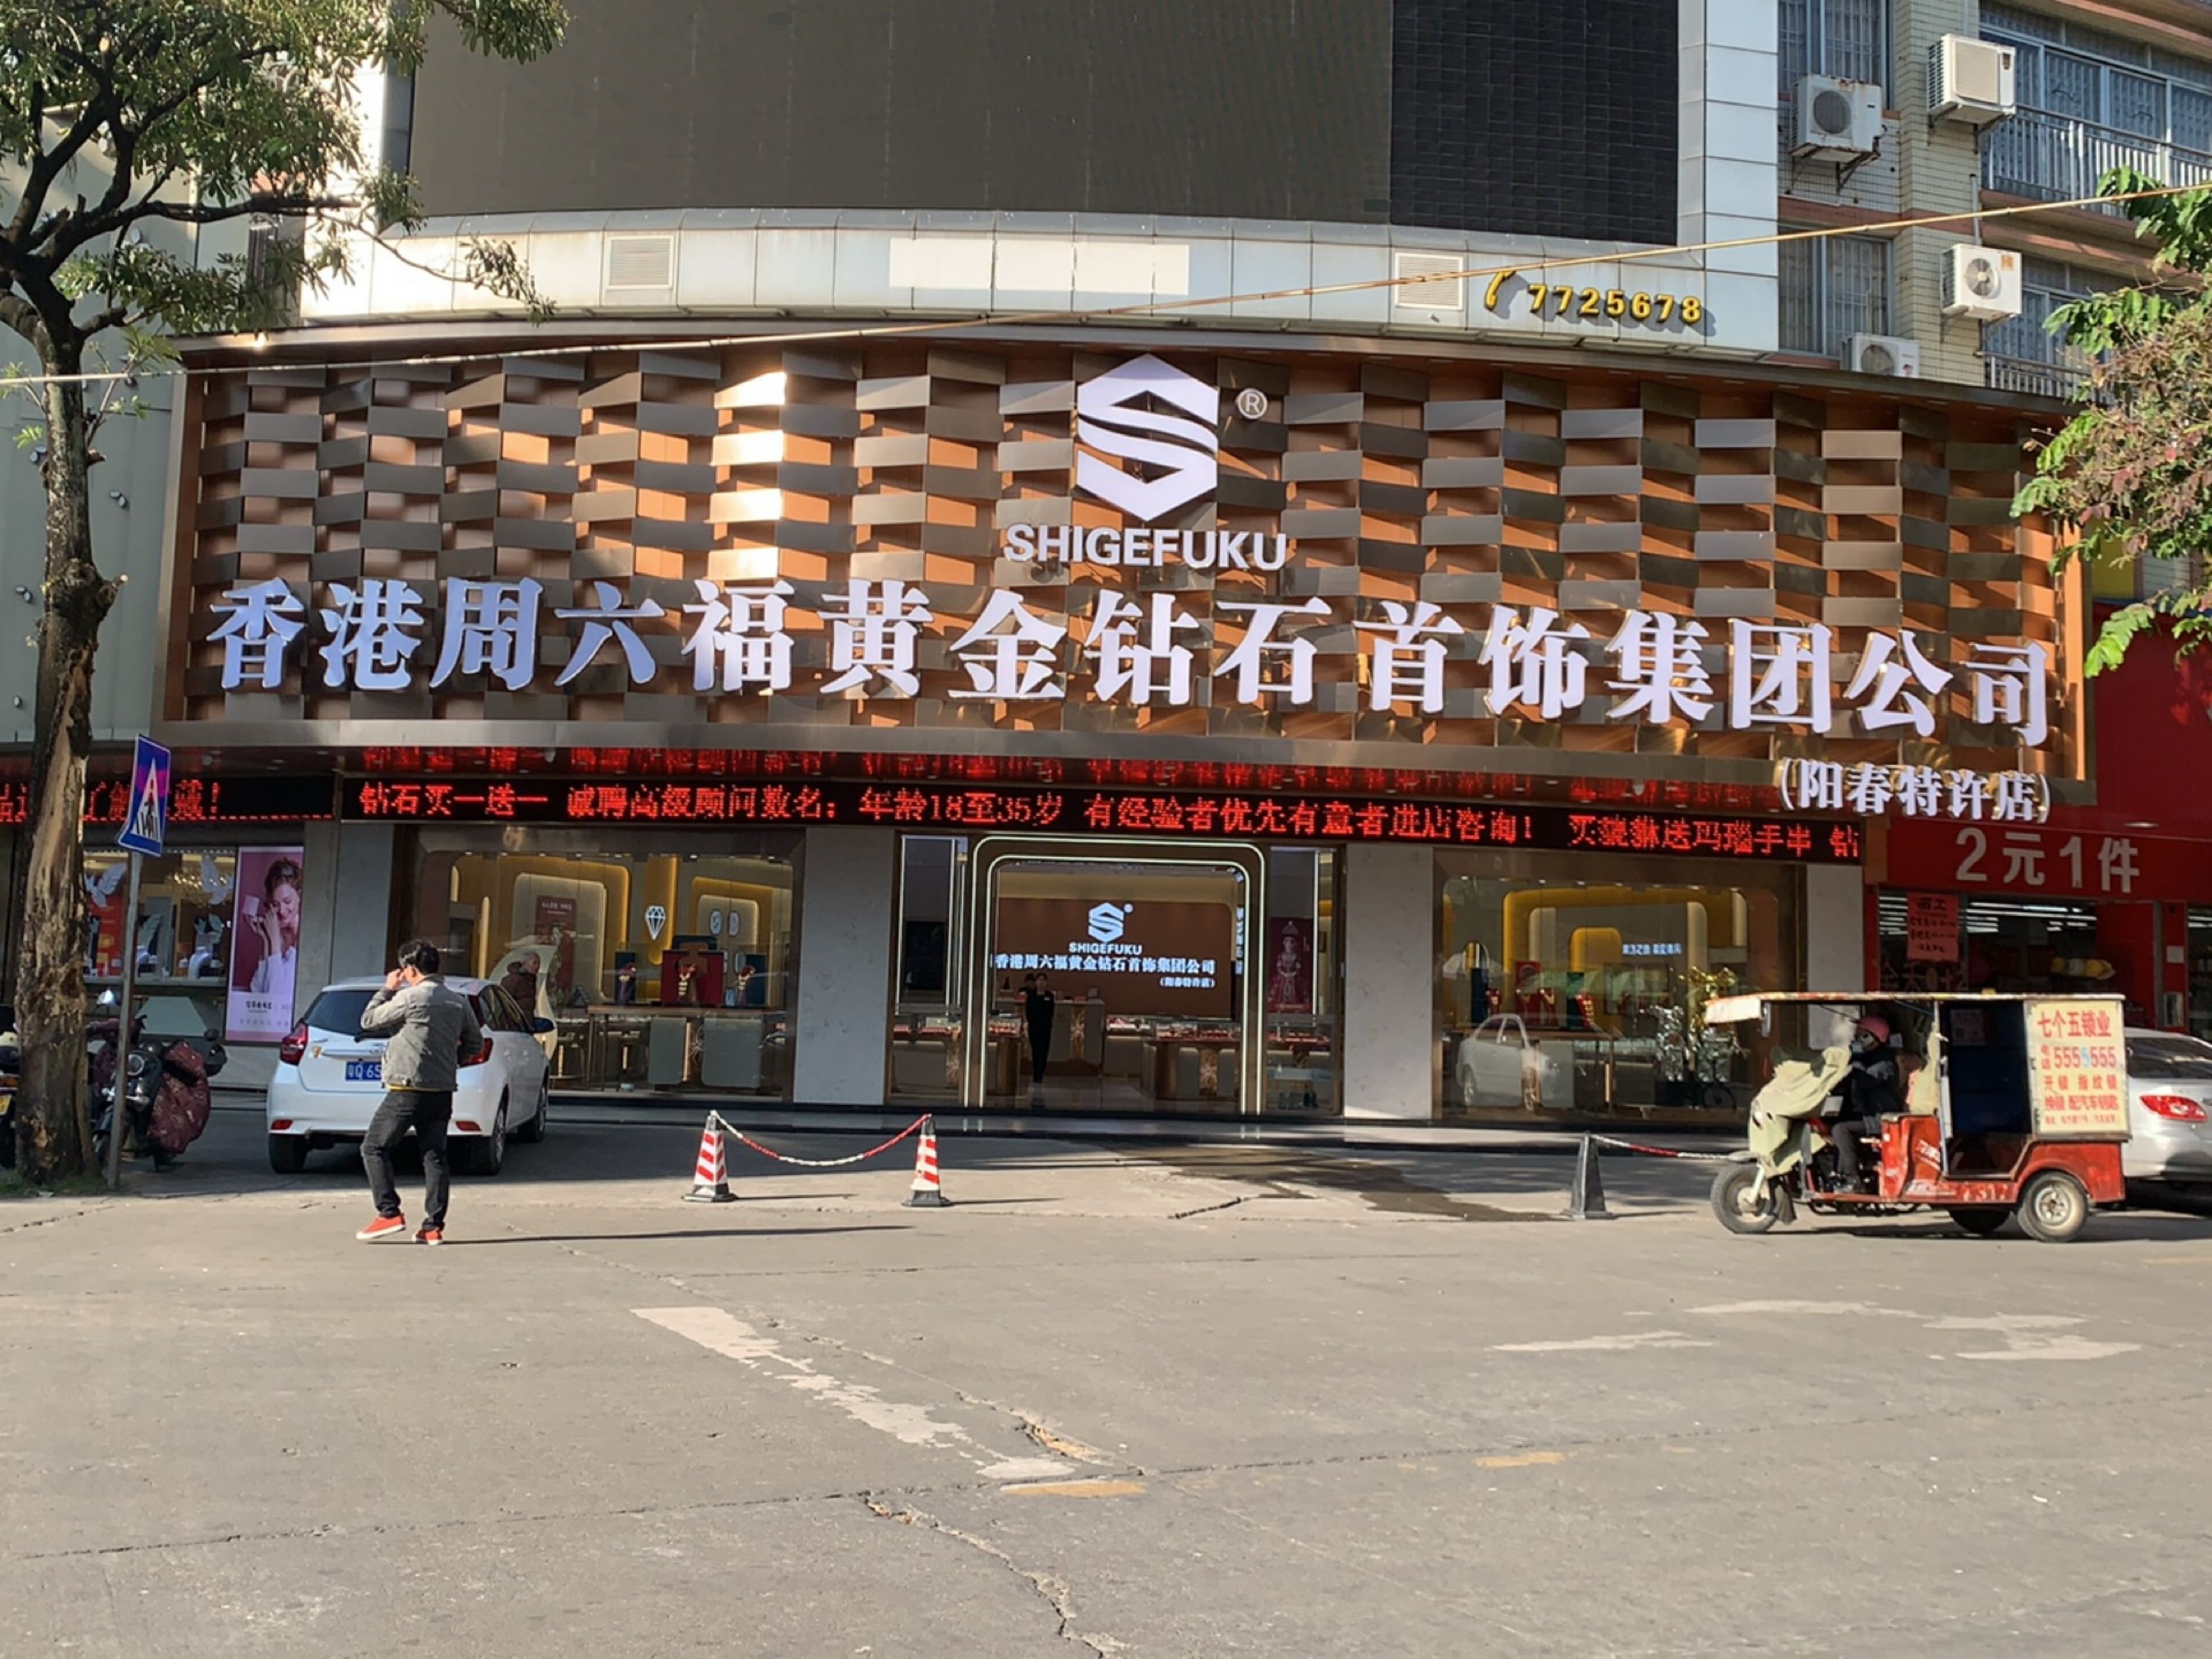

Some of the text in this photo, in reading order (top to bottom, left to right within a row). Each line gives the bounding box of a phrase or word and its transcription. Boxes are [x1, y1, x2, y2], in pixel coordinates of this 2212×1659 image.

[1528, 283, 1702, 325] 7725678
[1004, 524, 1288, 571] SHIGEFUKU
[207, 576, 2049, 748] 香港周六福黄金钻石首饰集团公司
[858, 786, 1064, 826] 年龄18至35岁
[1779, 757, 2051, 823] (阳春特许店)
[1955, 828, 2140, 894] 2元1件
[1068, 942, 1142, 956] SHIGEFUKU
[2037, 1010, 2112, 1038] 七个五锁业
[2053, 1046, 2117, 1069] 5555555
